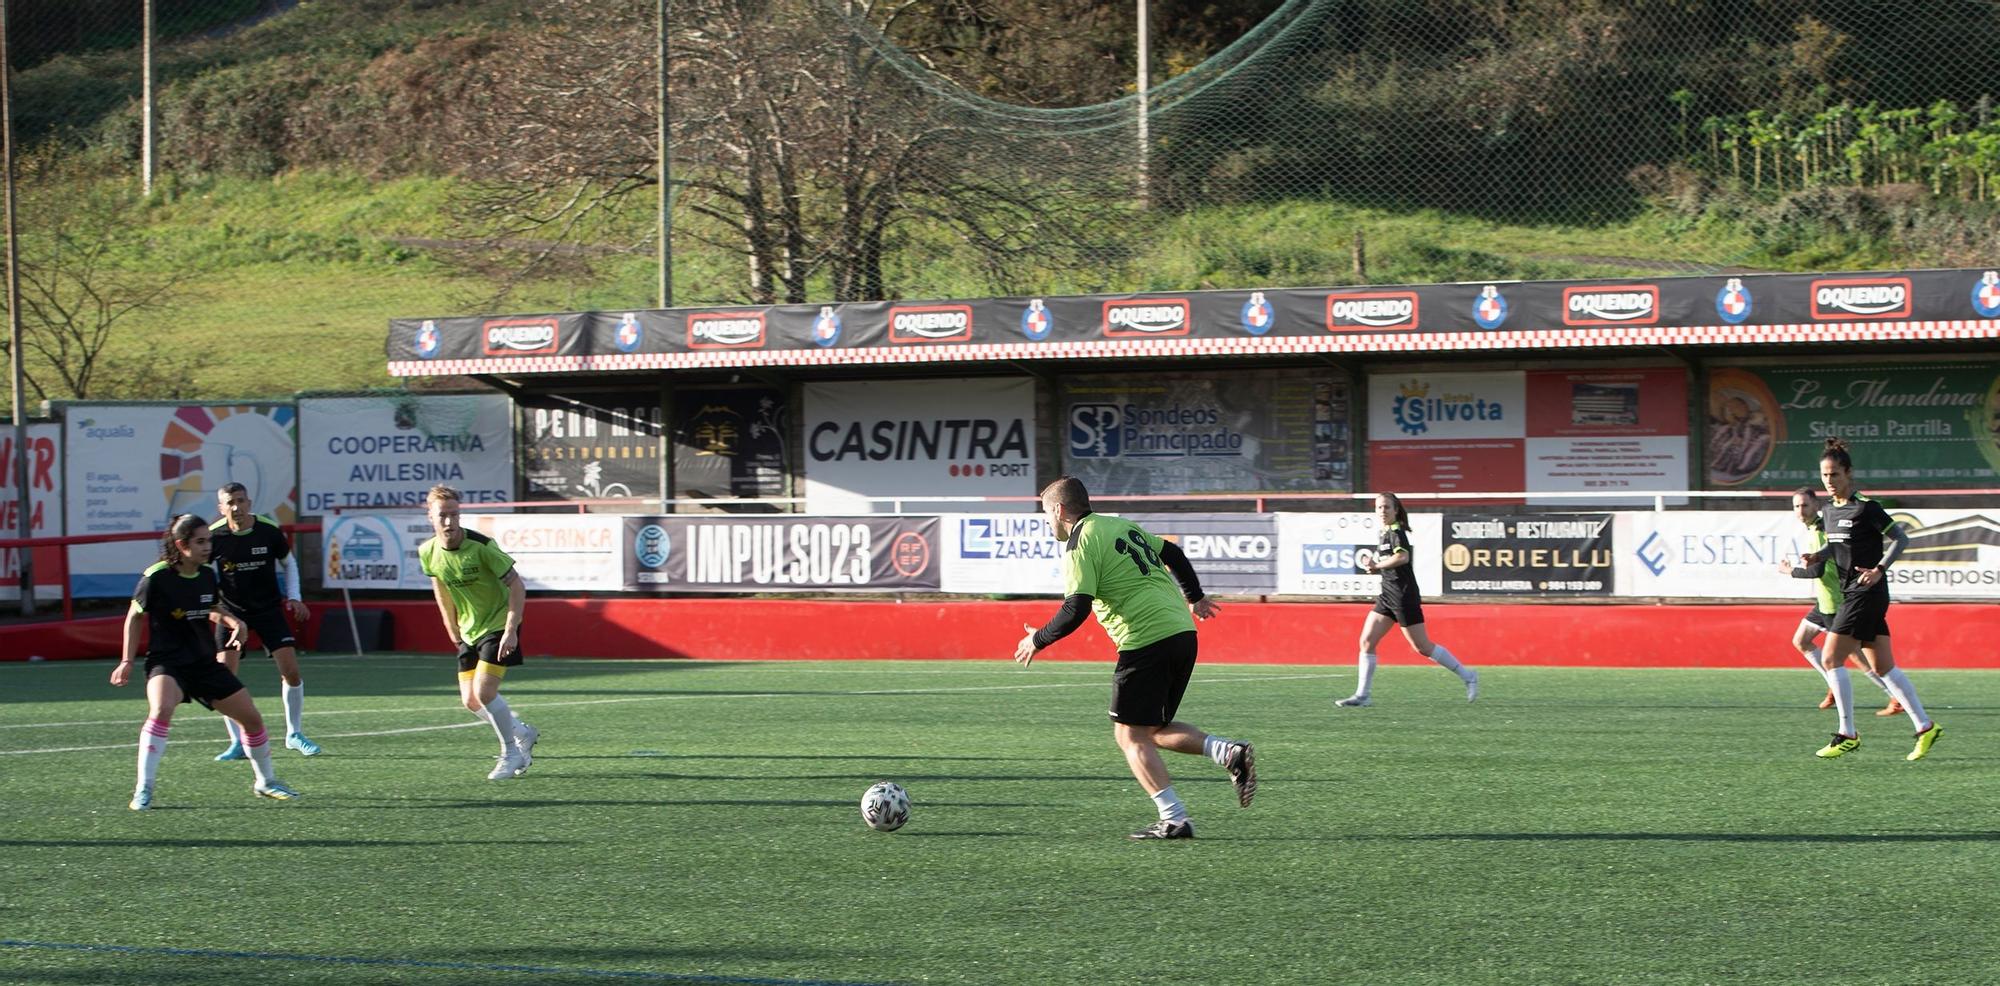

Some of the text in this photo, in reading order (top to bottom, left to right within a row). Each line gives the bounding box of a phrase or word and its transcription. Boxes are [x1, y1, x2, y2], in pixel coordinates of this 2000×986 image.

[1568, 293, 1653, 314] OQUENDO
[1816, 286, 1905, 307] OQUENDO
[1108, 306, 1184, 326] OQUENDO
[1332, 299, 1413, 320] OQUENDO
[692, 319, 761, 338] OQUENDO
[894, 311, 967, 331] OQUENDO
[488, 326, 554, 344] OQUENDO
[1781, 378, 1826, 409] La
[1124, 403, 1218, 425] Sondeos
[1408, 398, 1503, 421] Silvota
[86, 424, 135, 440] aqualia
[1886, 420, 1952, 436] Parrilla
[328, 434, 484, 455] COOPERATIVA
[809, 418, 1029, 461] CASINTRA
[1124, 427, 1243, 456] Principado
[349, 463, 464, 482] AVILESINA
[990, 463, 1030, 477] PORT
[307, 490, 507, 511] DE TRANSPTES
[1516, 521, 1601, 538] RESTAURANTE
[687, 523, 871, 585] IMPULSO23
[900, 543, 920, 552] RF
[1183, 535, 1271, 559] BANGO
[1682, 533, 1802, 566] ESENIA
[900, 555, 920, 565] EF
[1302, 580, 1382, 591] transpo
